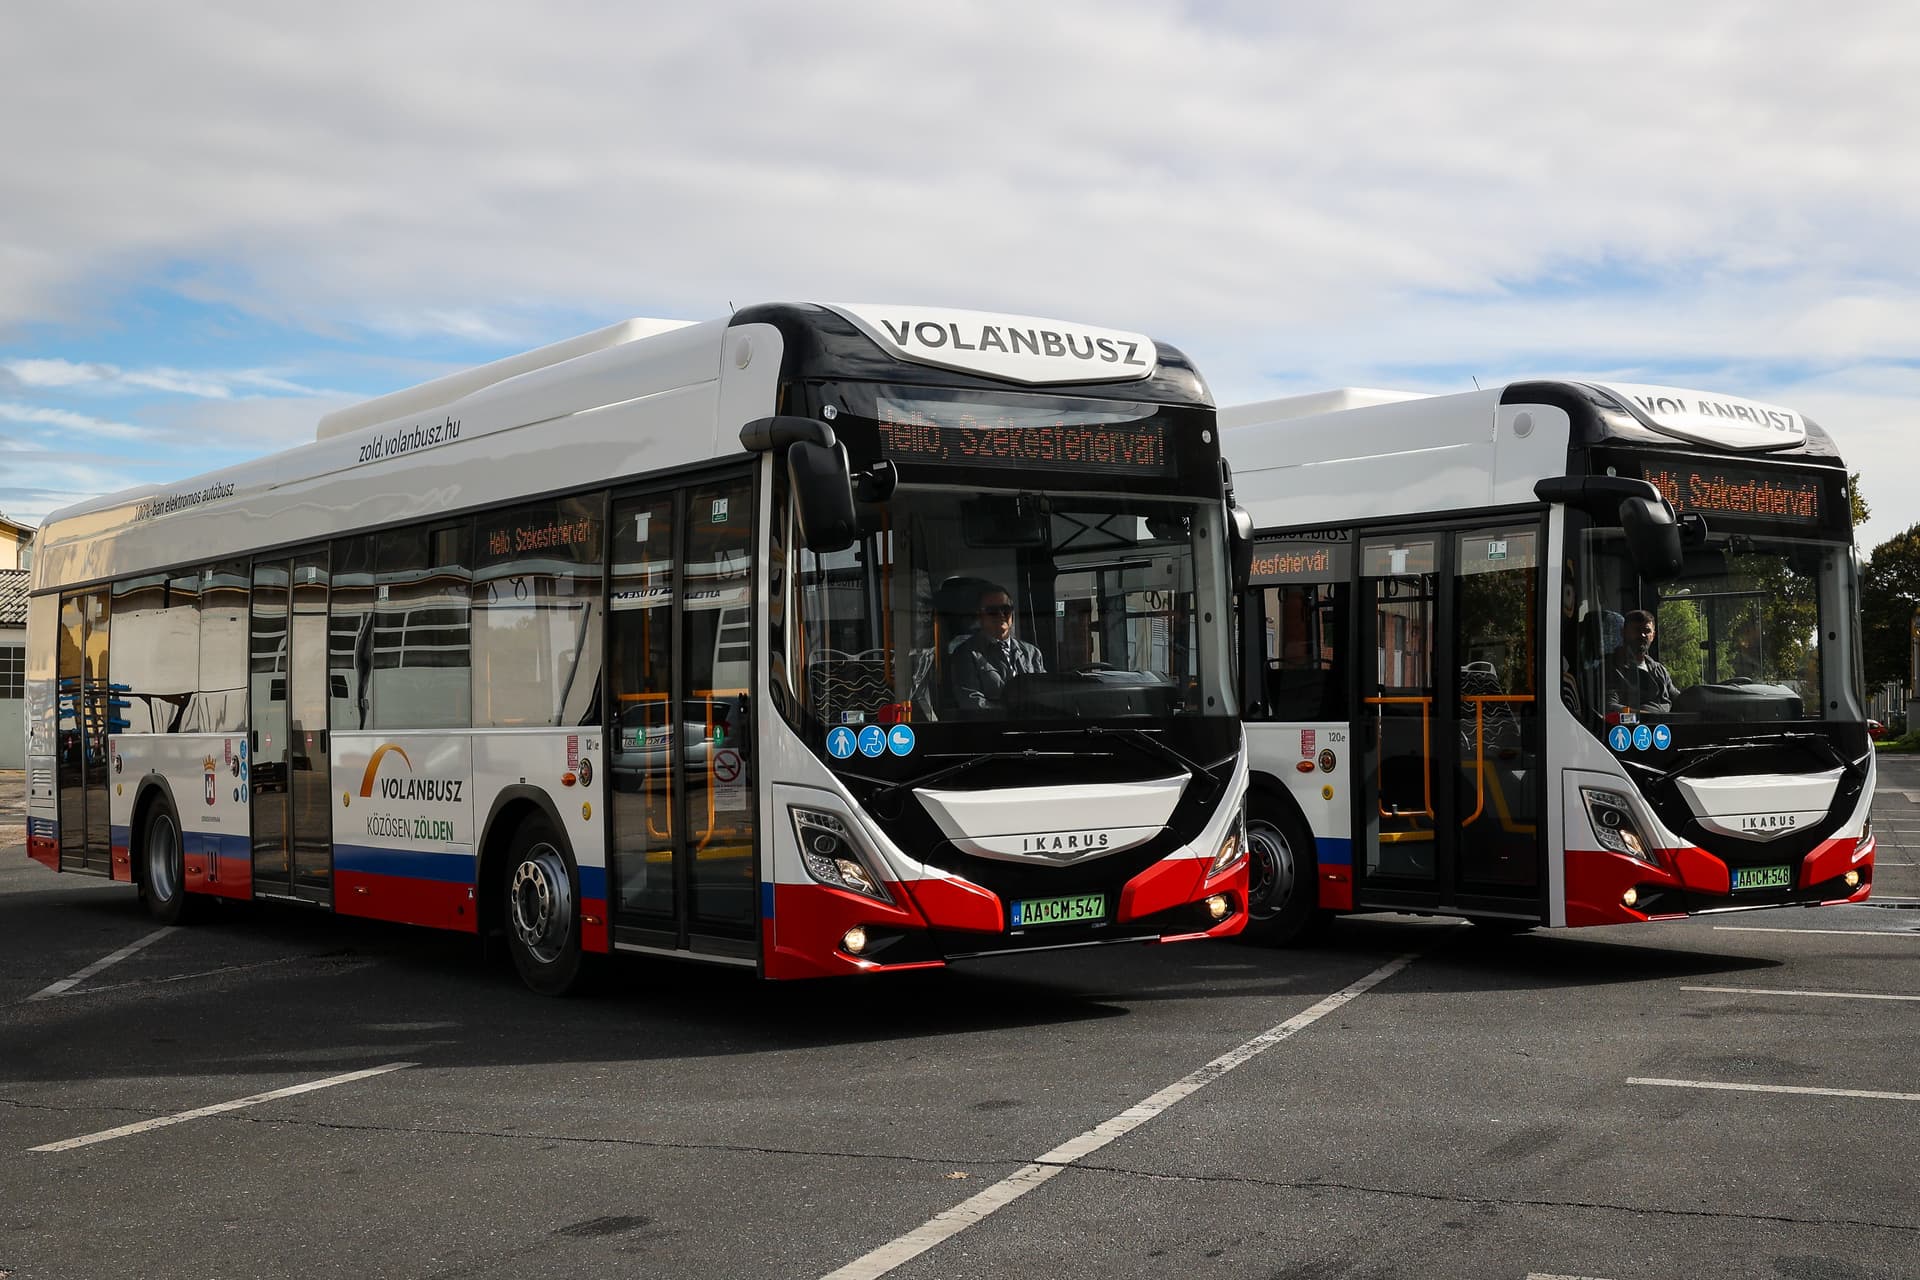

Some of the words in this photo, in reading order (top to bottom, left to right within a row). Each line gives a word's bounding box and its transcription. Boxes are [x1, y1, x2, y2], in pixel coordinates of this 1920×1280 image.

[881, 319, 1146, 366] VOLÁNBUSZ
[358, 416, 461, 462] zold.volanbusz.hu
[959, 410, 1165, 466] Székesfehérvár!
[164, 491, 201, 513] elektromos
[201, 481, 235, 502] autóbusz
[1689, 473, 1818, 517] Székesfehérvár!
[1328, 731, 1346, 742] 120e
[380, 777, 463, 803] VOLÁNBUSZ
[366, 811, 413, 841] KÖZÖSEN,
[413, 815, 454, 841] ZÖLDEN
[1742, 815, 1796, 829] IKARUS
[1023, 833, 1109, 852] IKARUS
